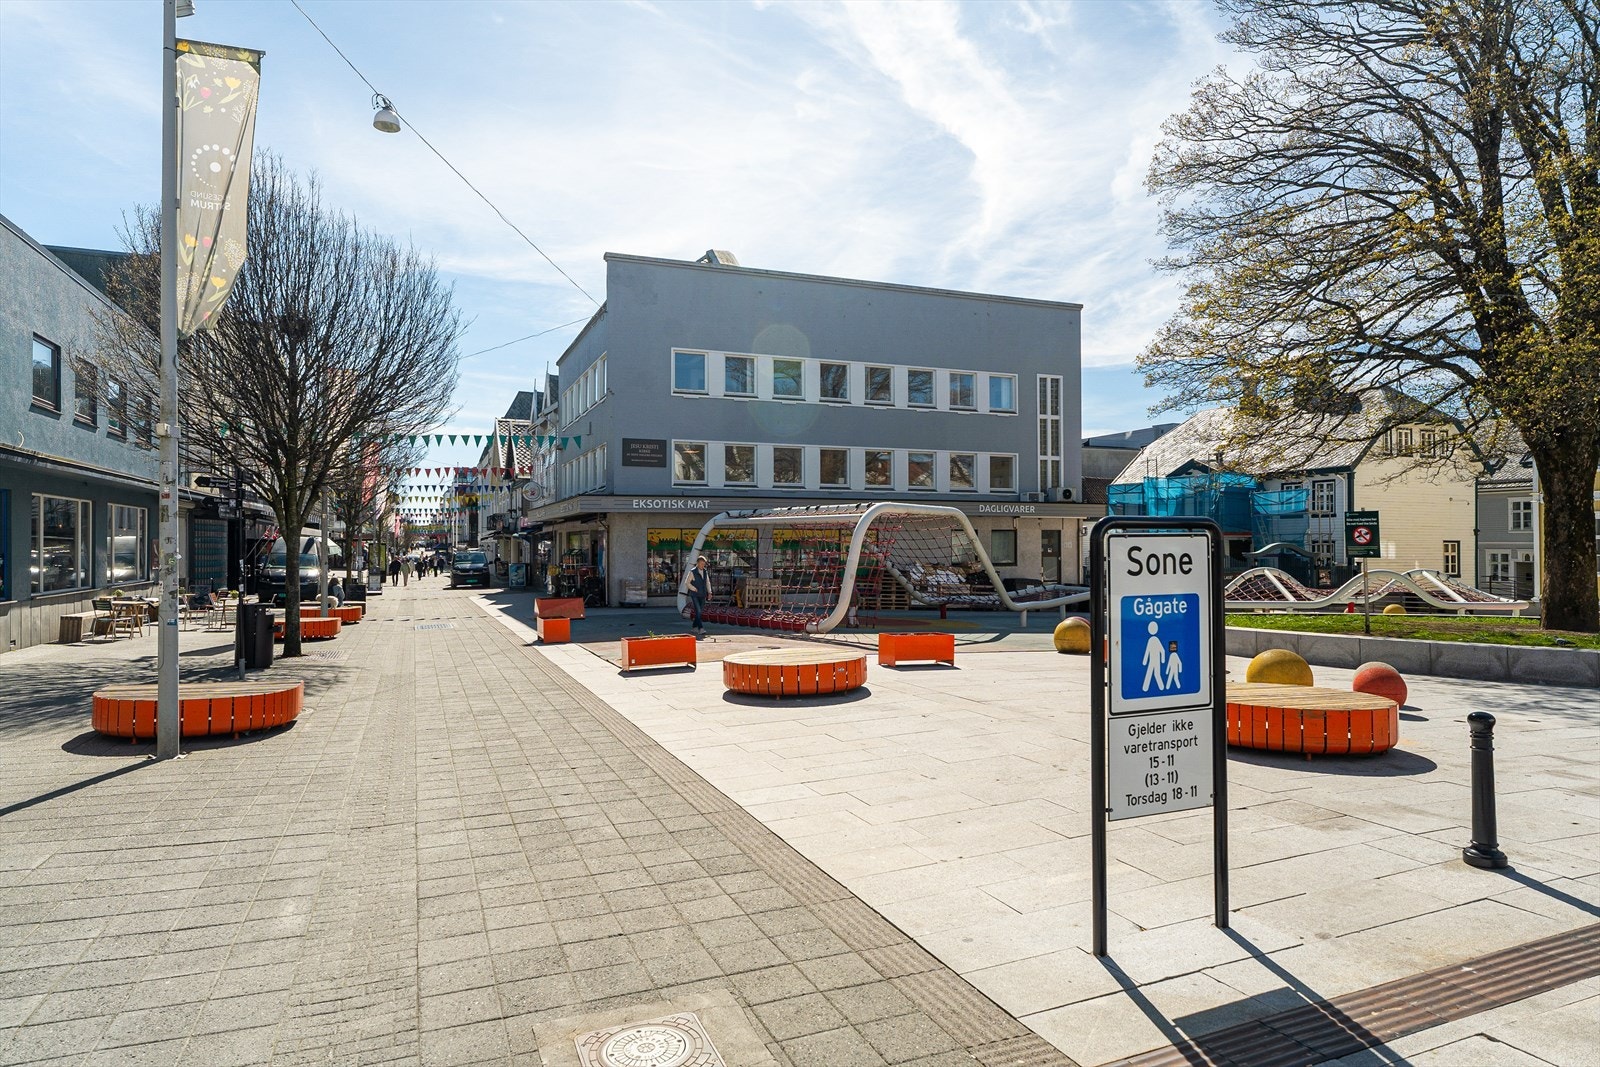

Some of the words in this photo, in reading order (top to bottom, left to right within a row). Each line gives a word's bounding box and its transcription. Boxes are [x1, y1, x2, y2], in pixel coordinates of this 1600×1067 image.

[632, 499, 685, 509] EKSOTISK
[687, 500, 710, 509] MAT
[978, 504, 1036, 514] DAGLIGVARER
[1126, 545, 1193, 577] Sone
[1133, 597, 1188, 619] Gågate
[1128, 721, 1167, 739] Gjelder
[1172, 718, 1194, 732] ikke
[1123, 734, 1199, 755] varetransport
[1125, 791, 1168, 807] Torsdag
